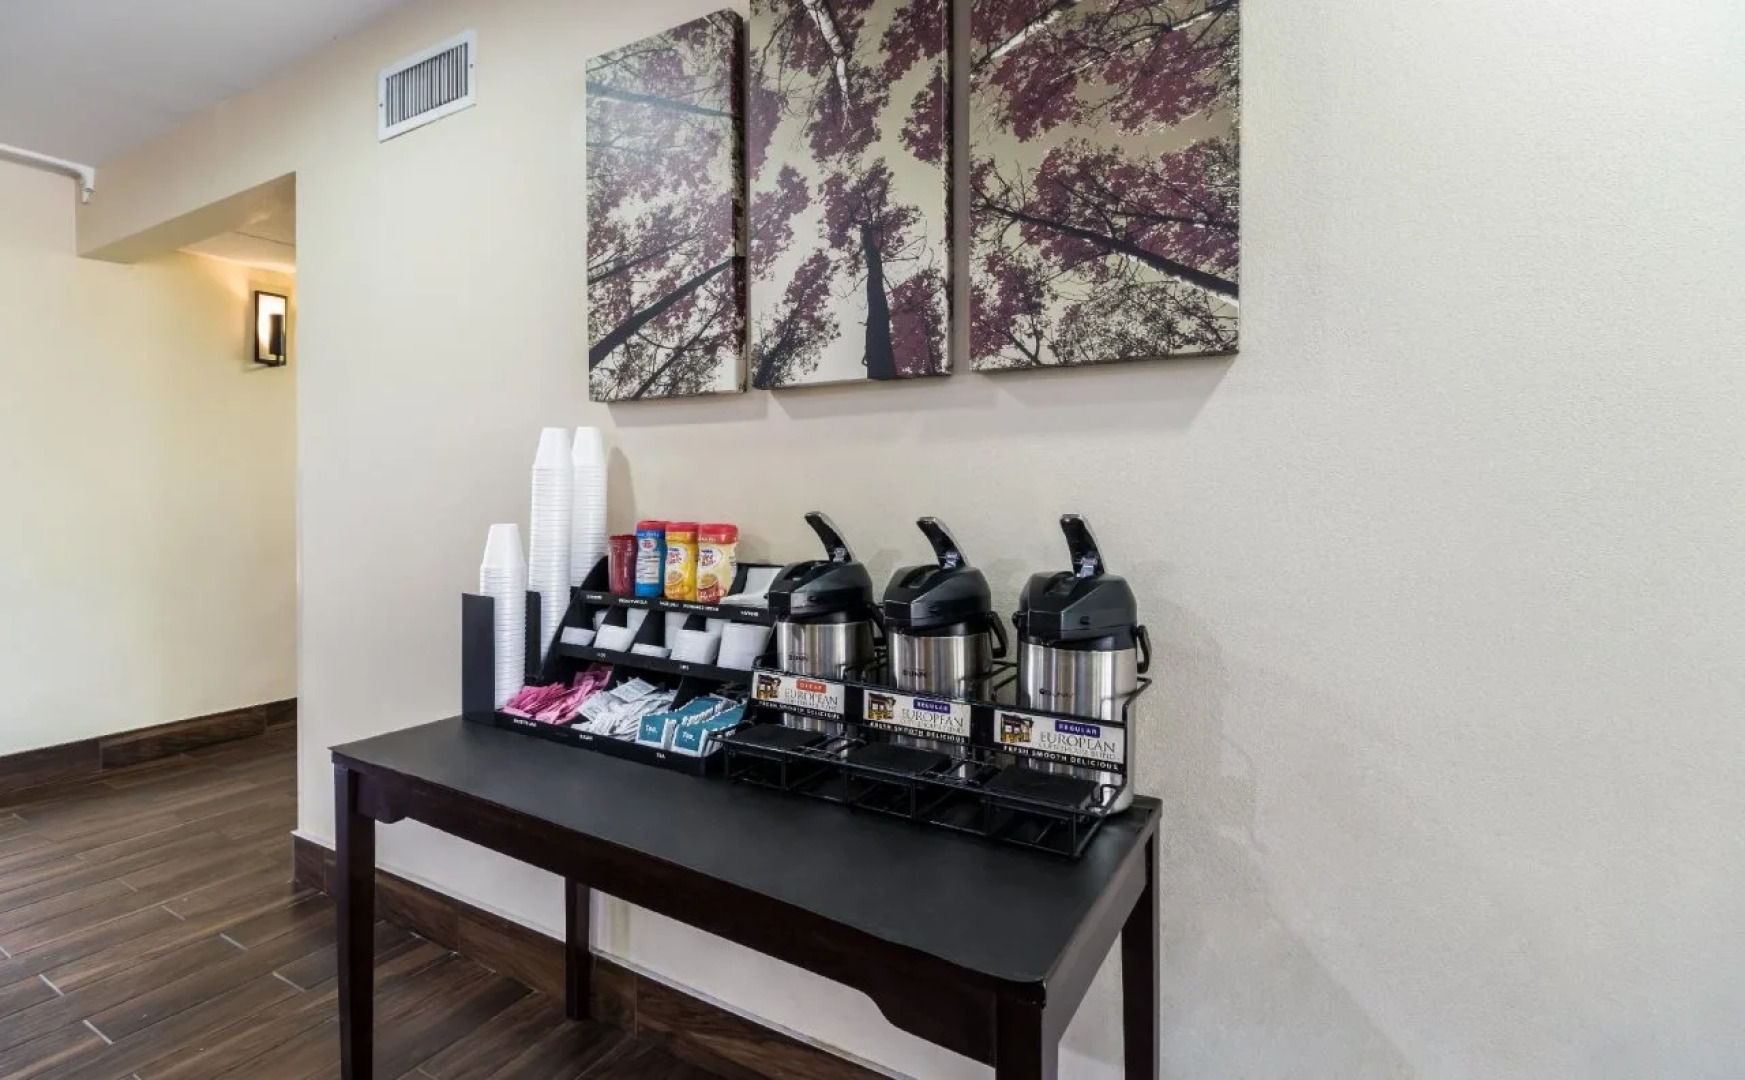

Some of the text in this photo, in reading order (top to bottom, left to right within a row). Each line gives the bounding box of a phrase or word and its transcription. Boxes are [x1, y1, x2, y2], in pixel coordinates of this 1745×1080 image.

[902, 709, 964, 728] EUROPEAN
[926, 731, 965, 743] DELICIOUS
[1058, 723, 1098, 736] REGULAR
[1040, 731, 1116, 753] EUROPEAN
[1004, 744, 1119, 771] FRESH SMOOTH DELICIOUS
